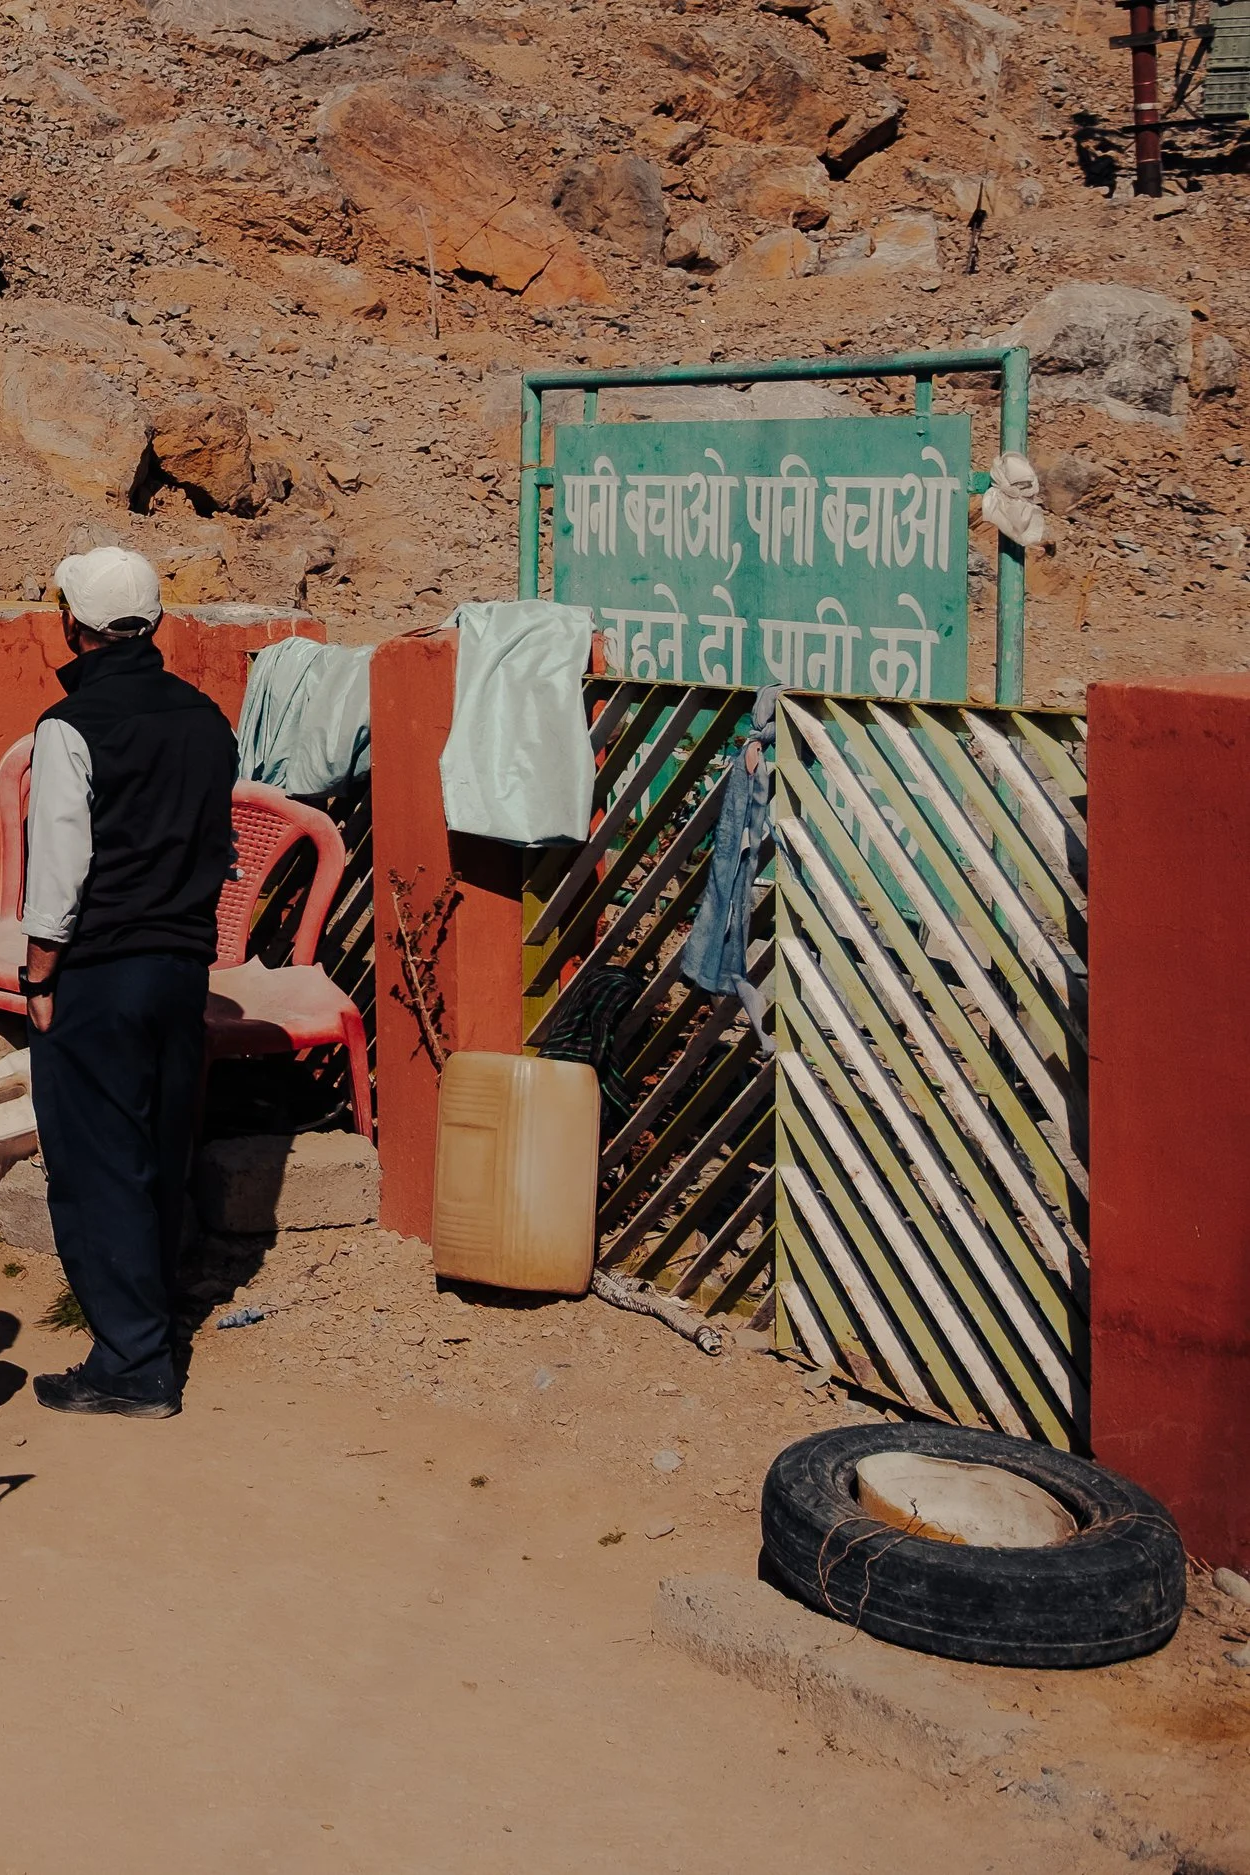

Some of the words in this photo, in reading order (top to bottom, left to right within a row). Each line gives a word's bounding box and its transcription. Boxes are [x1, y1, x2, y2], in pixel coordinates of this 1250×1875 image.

[562, 456, 621, 556] पानी
[624, 448, 744, 581] बचाओ,
[745, 454, 819, 567] पानी
[822, 446, 961, 574] बचाओ
[698, 584, 748, 686] दो
[758, 597, 862, 694] पानी
[869, 593, 941, 700] को
